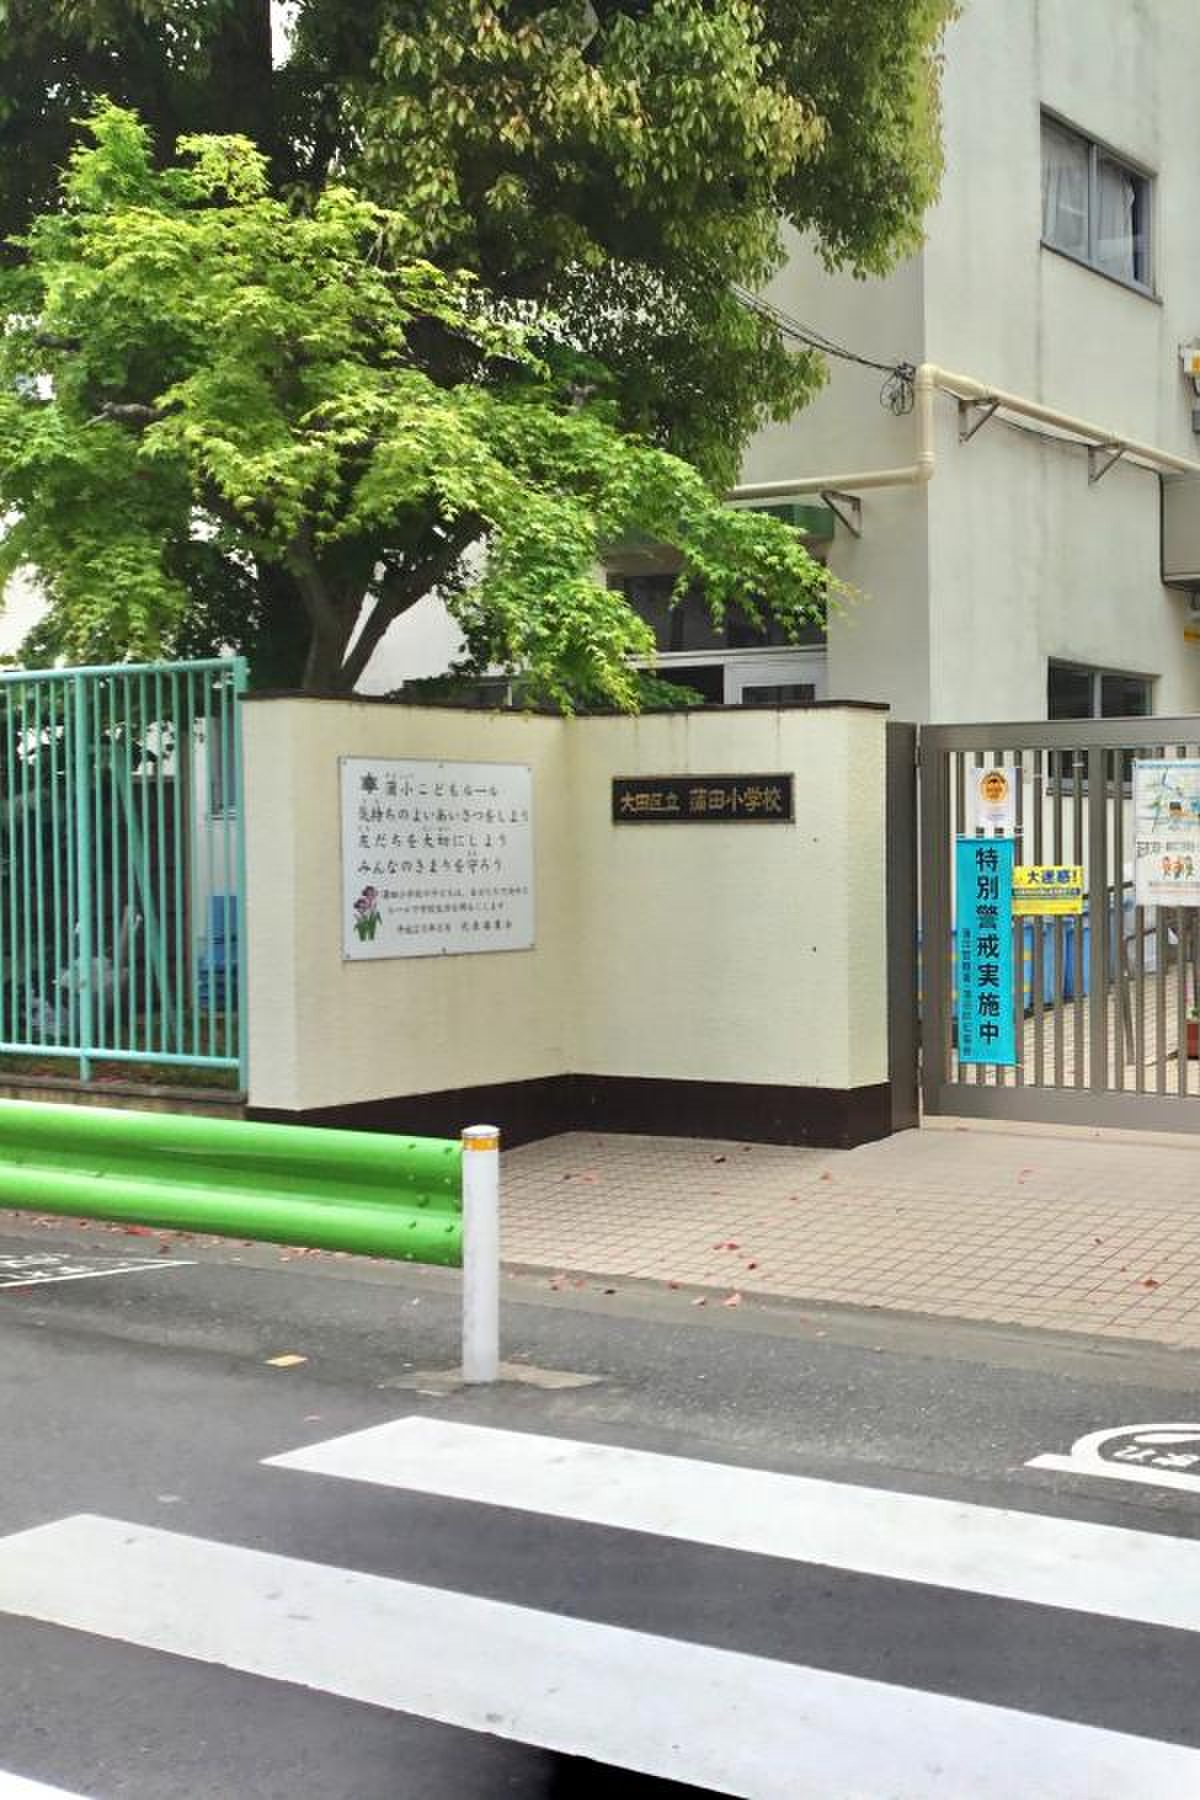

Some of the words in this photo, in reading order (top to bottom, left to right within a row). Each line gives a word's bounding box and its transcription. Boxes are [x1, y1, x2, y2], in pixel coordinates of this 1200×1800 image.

[619, 791, 681, 812] 大田区立
[688, 785, 783, 813] 蒲田小学校
[975, 847, 1001, 1046] 特別警戒実施中
